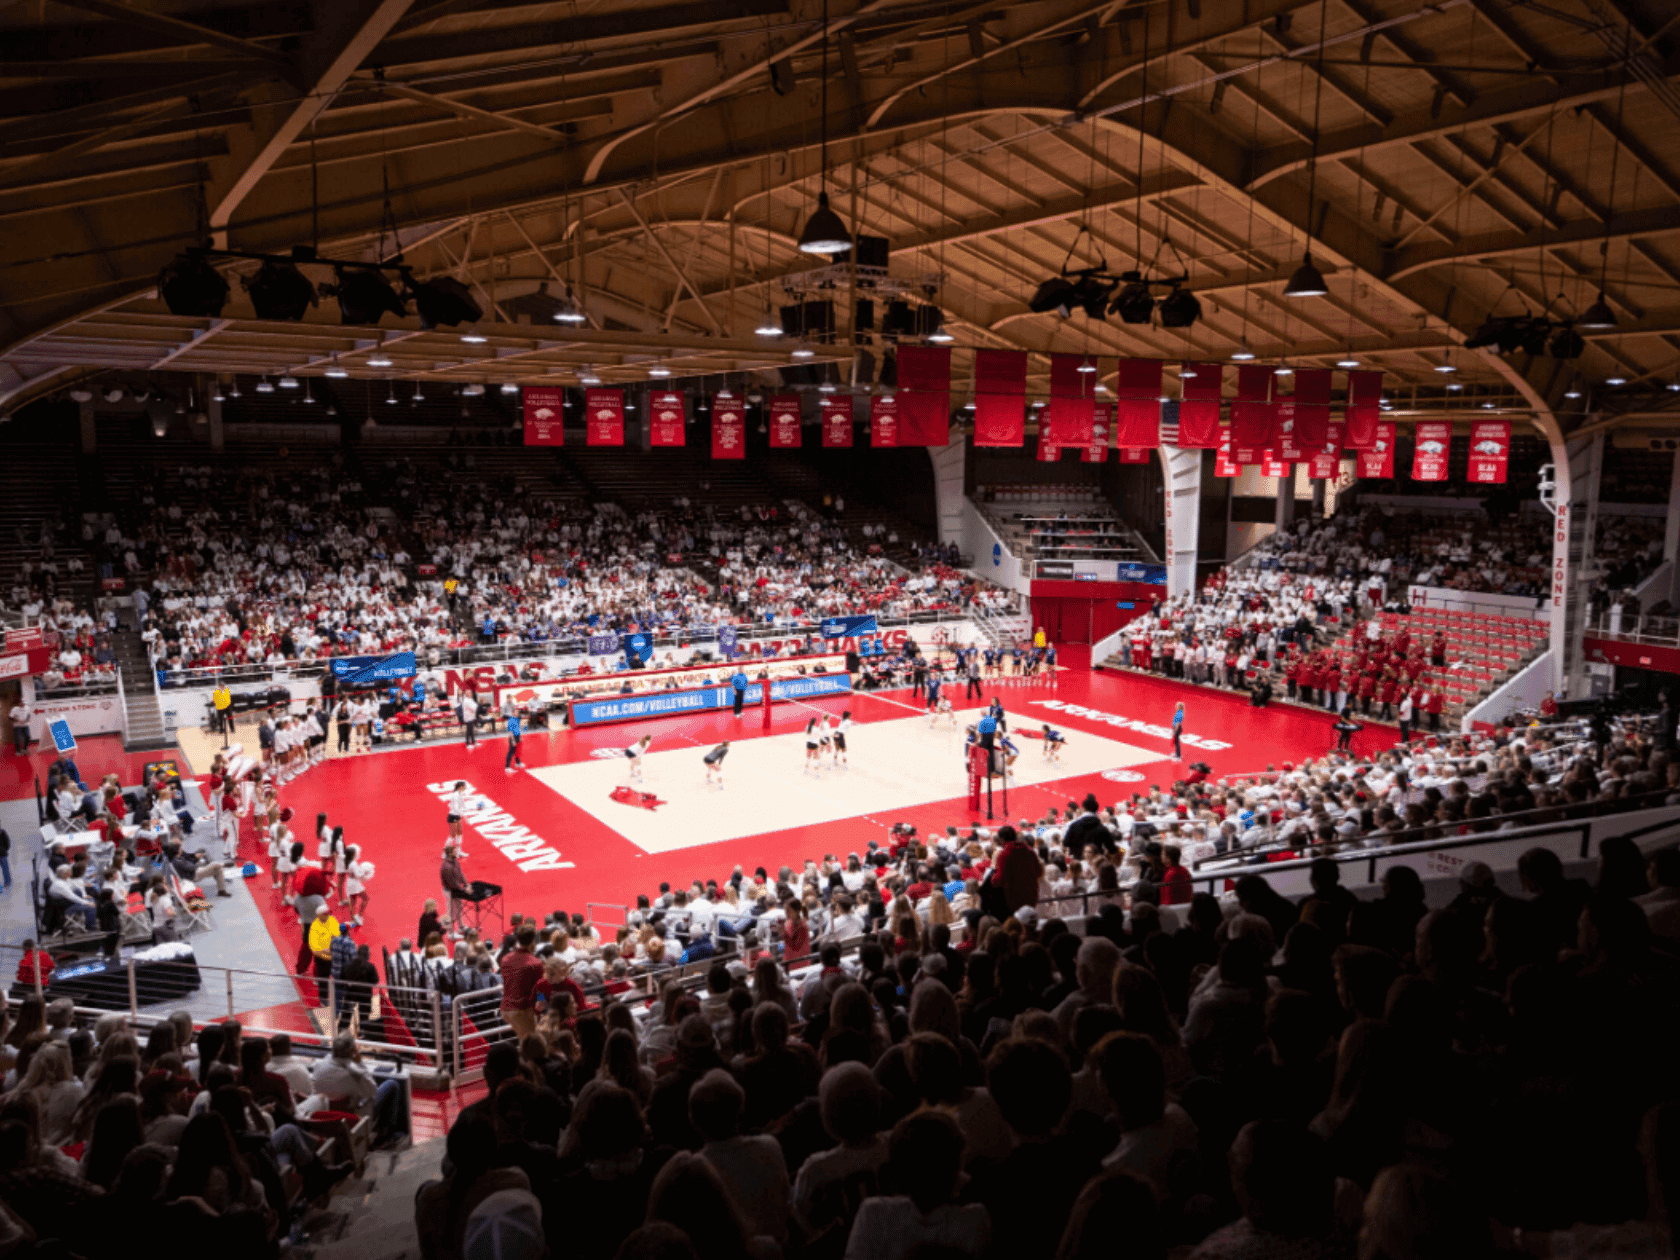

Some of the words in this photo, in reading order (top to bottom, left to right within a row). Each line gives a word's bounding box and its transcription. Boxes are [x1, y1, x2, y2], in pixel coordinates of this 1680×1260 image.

[1556, 505, 1567, 542] RED
[1554, 557, 1565, 606] ZONE
[592, 694, 704, 718] NCAA.COM/VOLLEYBALL
